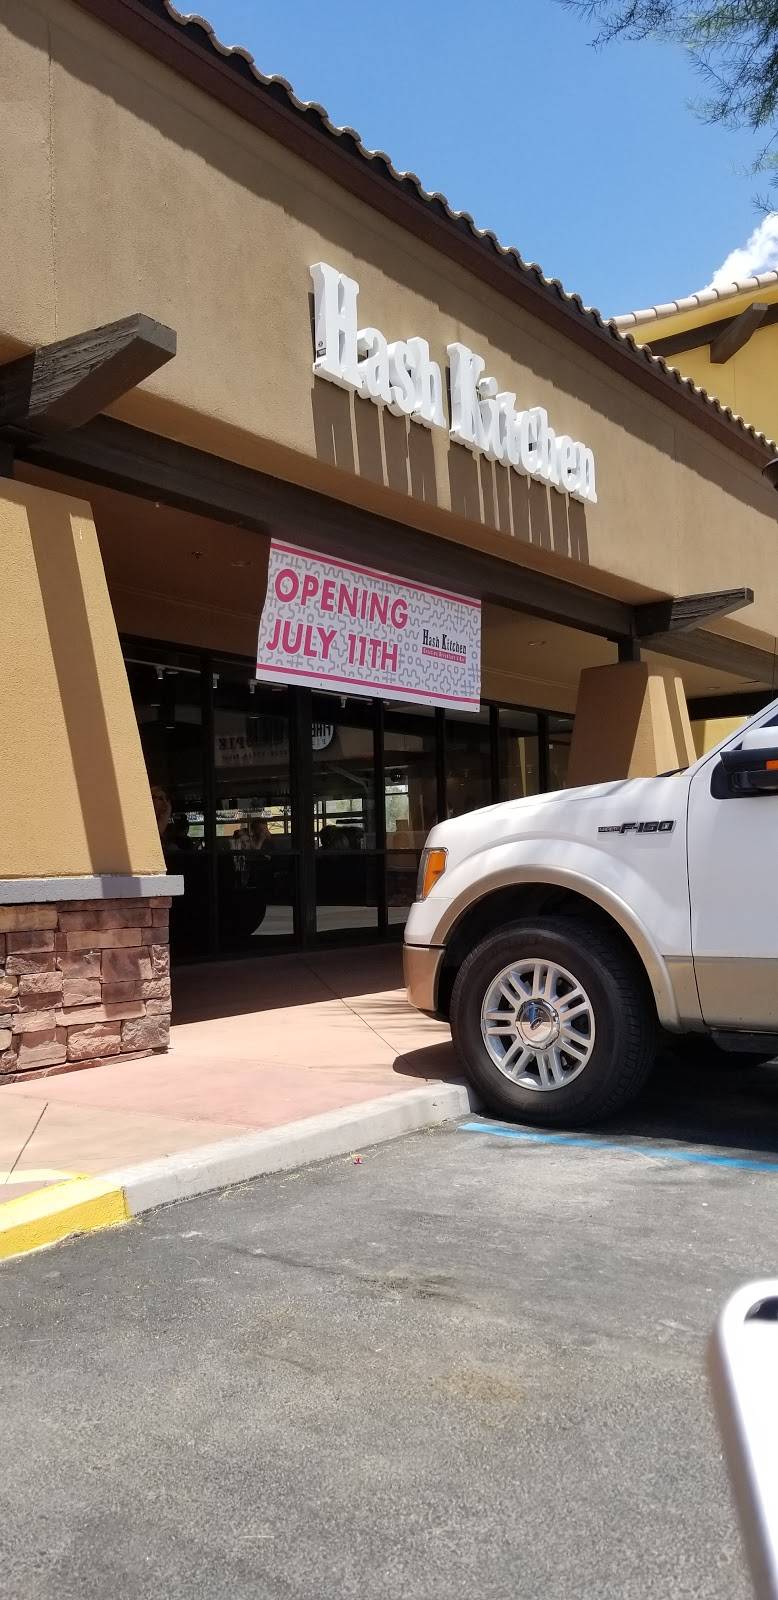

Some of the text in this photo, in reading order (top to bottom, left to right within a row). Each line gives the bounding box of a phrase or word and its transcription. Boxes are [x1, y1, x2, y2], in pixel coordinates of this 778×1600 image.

[310, 262, 597, 504] Hash Kitchen
[274, 568, 409, 629] OPENING
[266, 618, 337, 660] JULY
[348, 633, 398, 672] 11TH
[422, 628, 467, 654] Hash Kitchen
[620, 820, 674, 833] F-150
